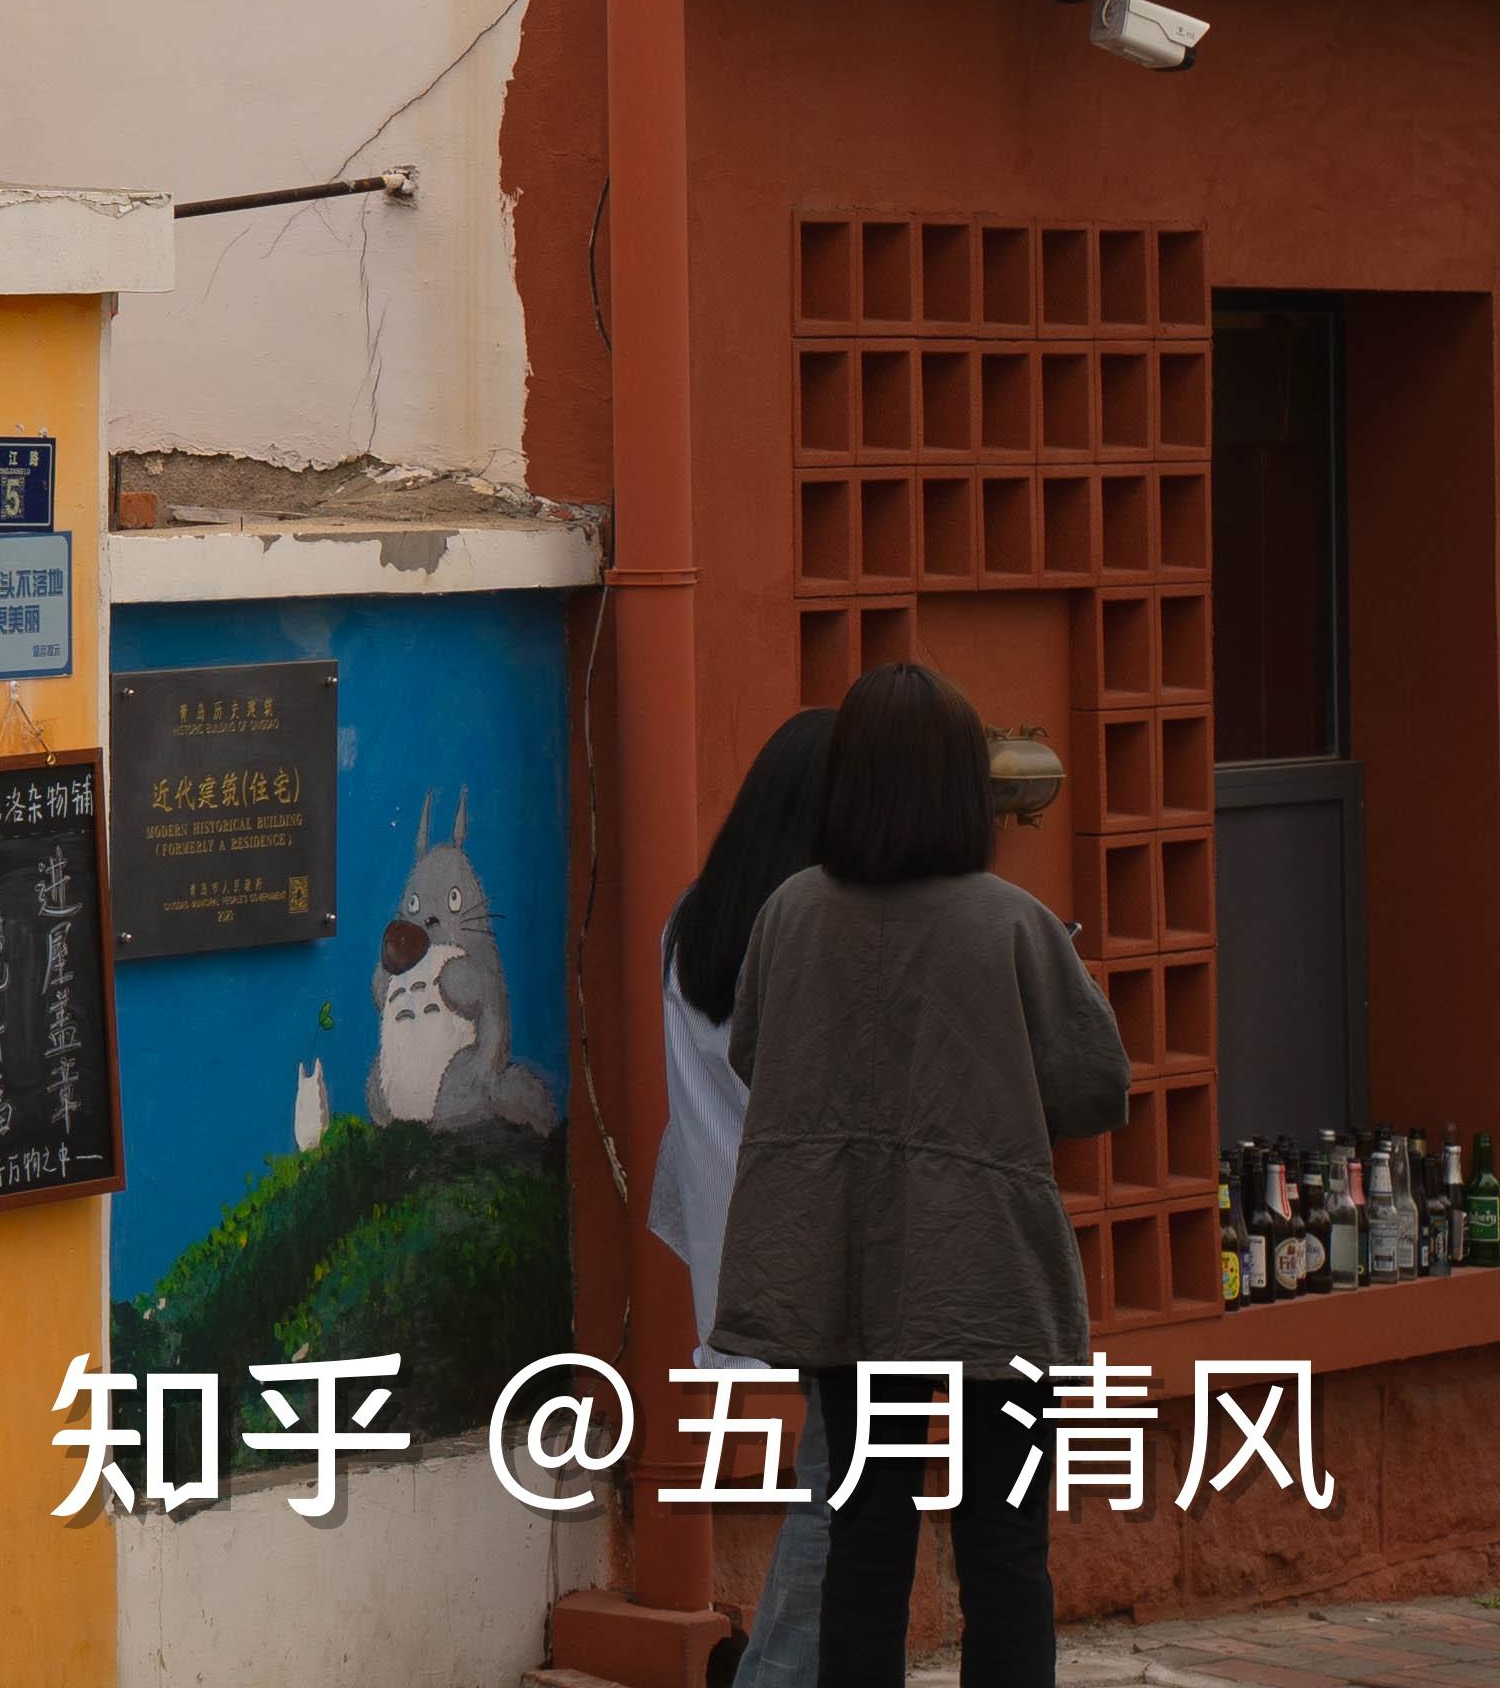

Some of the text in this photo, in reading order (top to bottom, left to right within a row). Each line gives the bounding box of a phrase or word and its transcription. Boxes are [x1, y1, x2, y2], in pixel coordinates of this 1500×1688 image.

[5, 478, 21, 516] 5
[146, 813, 303, 840] MODERN HISTORICAL BUILDING
[219, 840, 226, 851] A
[35, 844, 83, 1135] 进屋盖章
